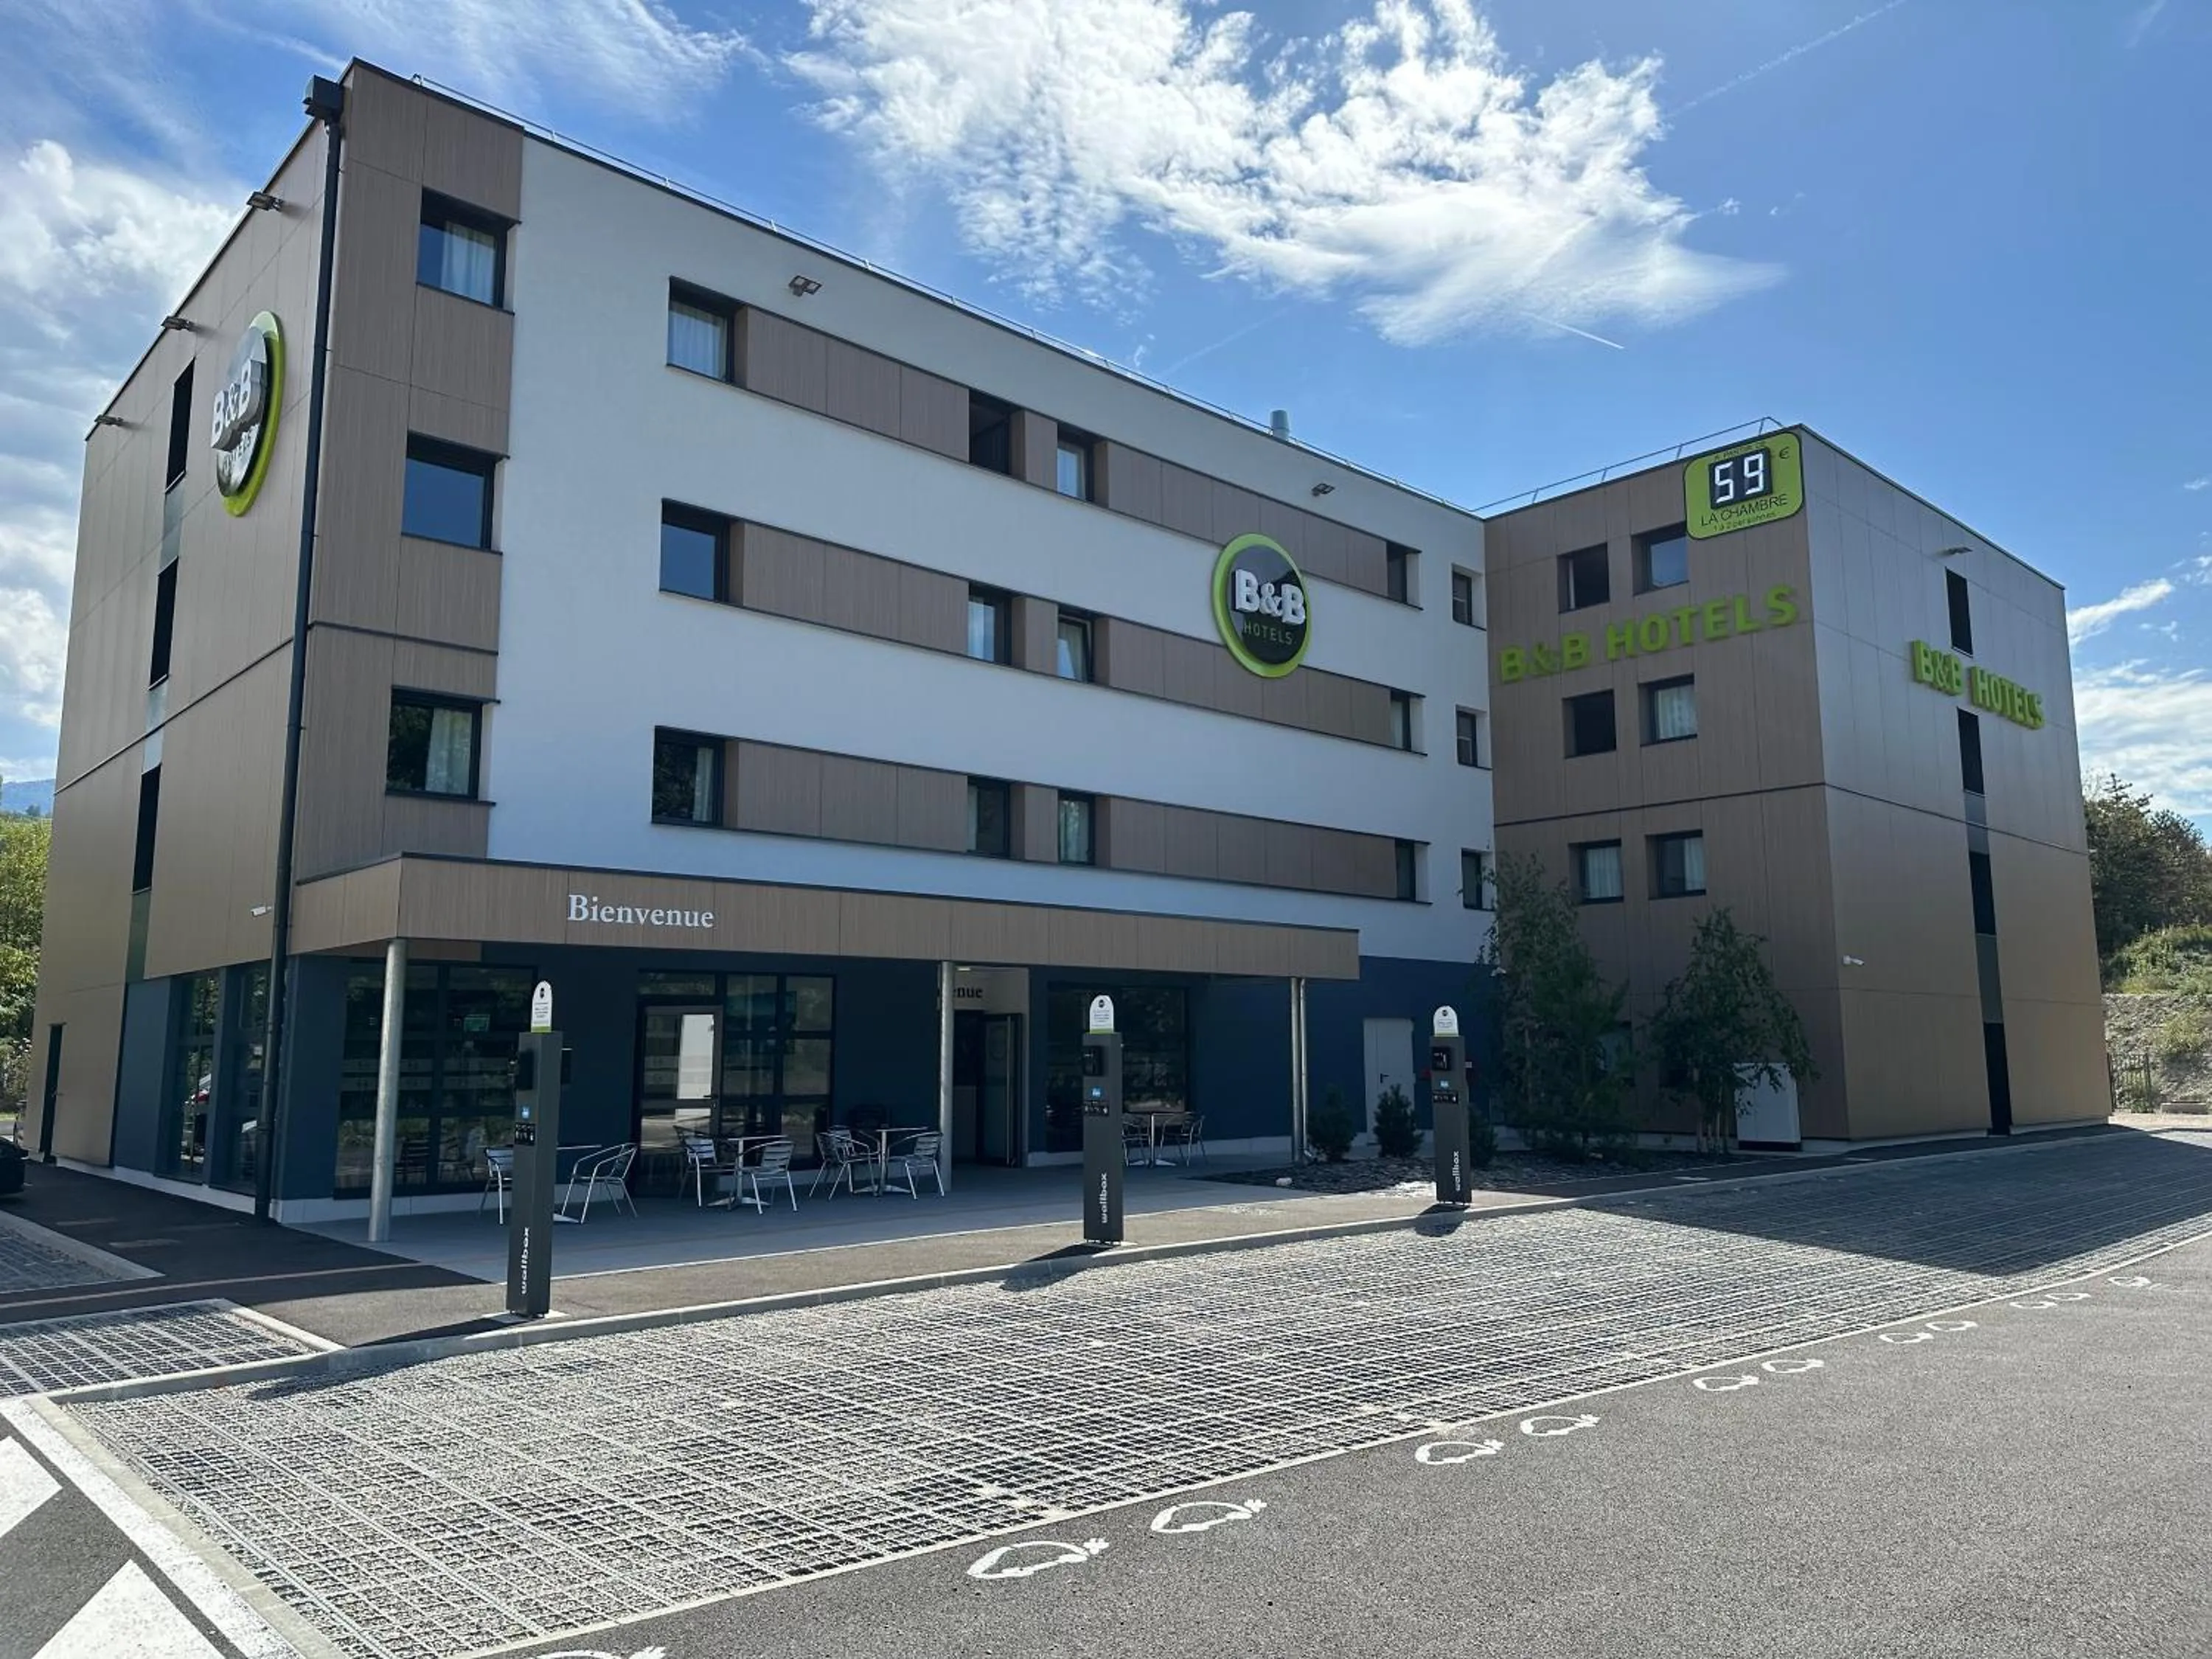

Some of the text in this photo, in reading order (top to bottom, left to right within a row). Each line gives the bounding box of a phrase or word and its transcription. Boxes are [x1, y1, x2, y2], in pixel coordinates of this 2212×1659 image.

[211, 359, 253, 448] B&B
[1714, 453, 1764, 504] 59
[1700, 494, 1789, 526] LA CHAMBRE
[1233, 568, 1306, 625] B&B
[1243, 619, 1293, 645] HOTELS
[1499, 583, 1800, 684] B&B HOTELS
[1910, 639, 2045, 731] B&B HOTELS
[567, 894, 715, 928] Bienvenue
[1099, 1172, 1107, 1224] wallbox
